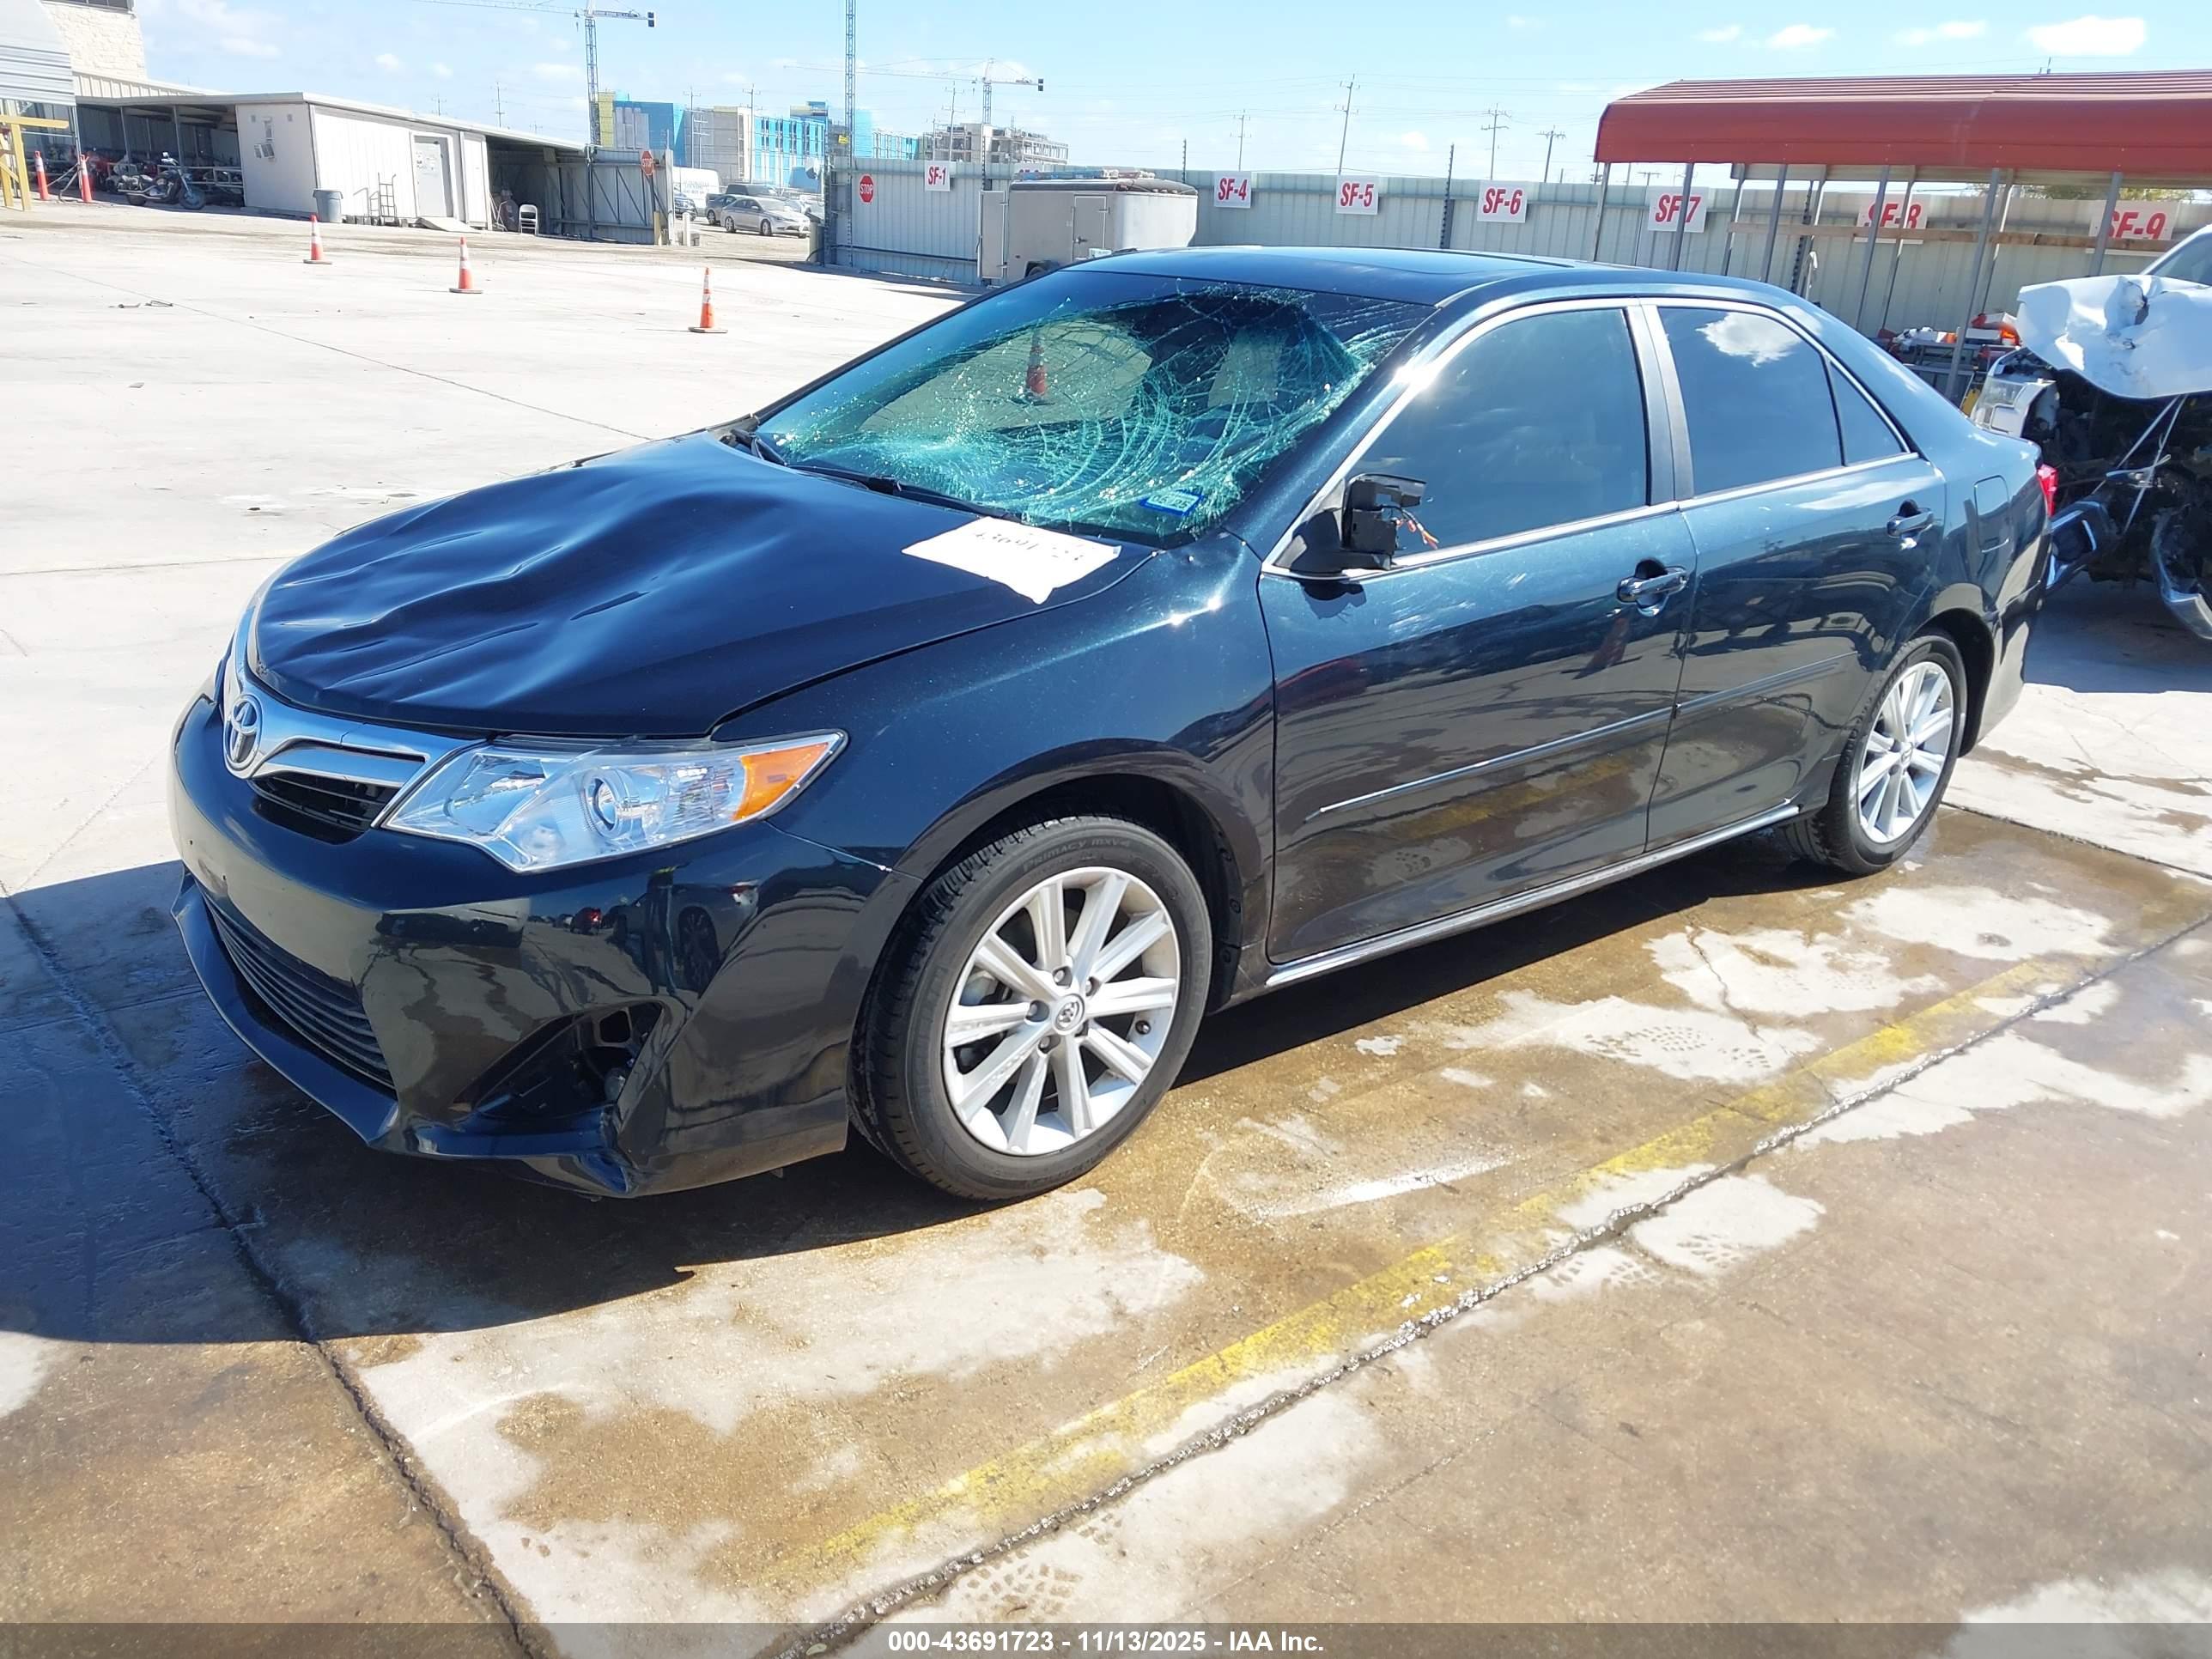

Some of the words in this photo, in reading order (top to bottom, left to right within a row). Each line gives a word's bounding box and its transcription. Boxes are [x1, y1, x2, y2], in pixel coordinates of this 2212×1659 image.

[928, 166, 946, 185] SF-1
[860, 183, 873, 195] STOP
[1218, 177, 1248, 201] SF-4
[1340, 182, 1375, 207] SF-5
[1482, 188, 1523, 215] SF-6
[1655, 194, 1702, 223] SF7
[1023, 838, 1087, 873] PRIMACY
